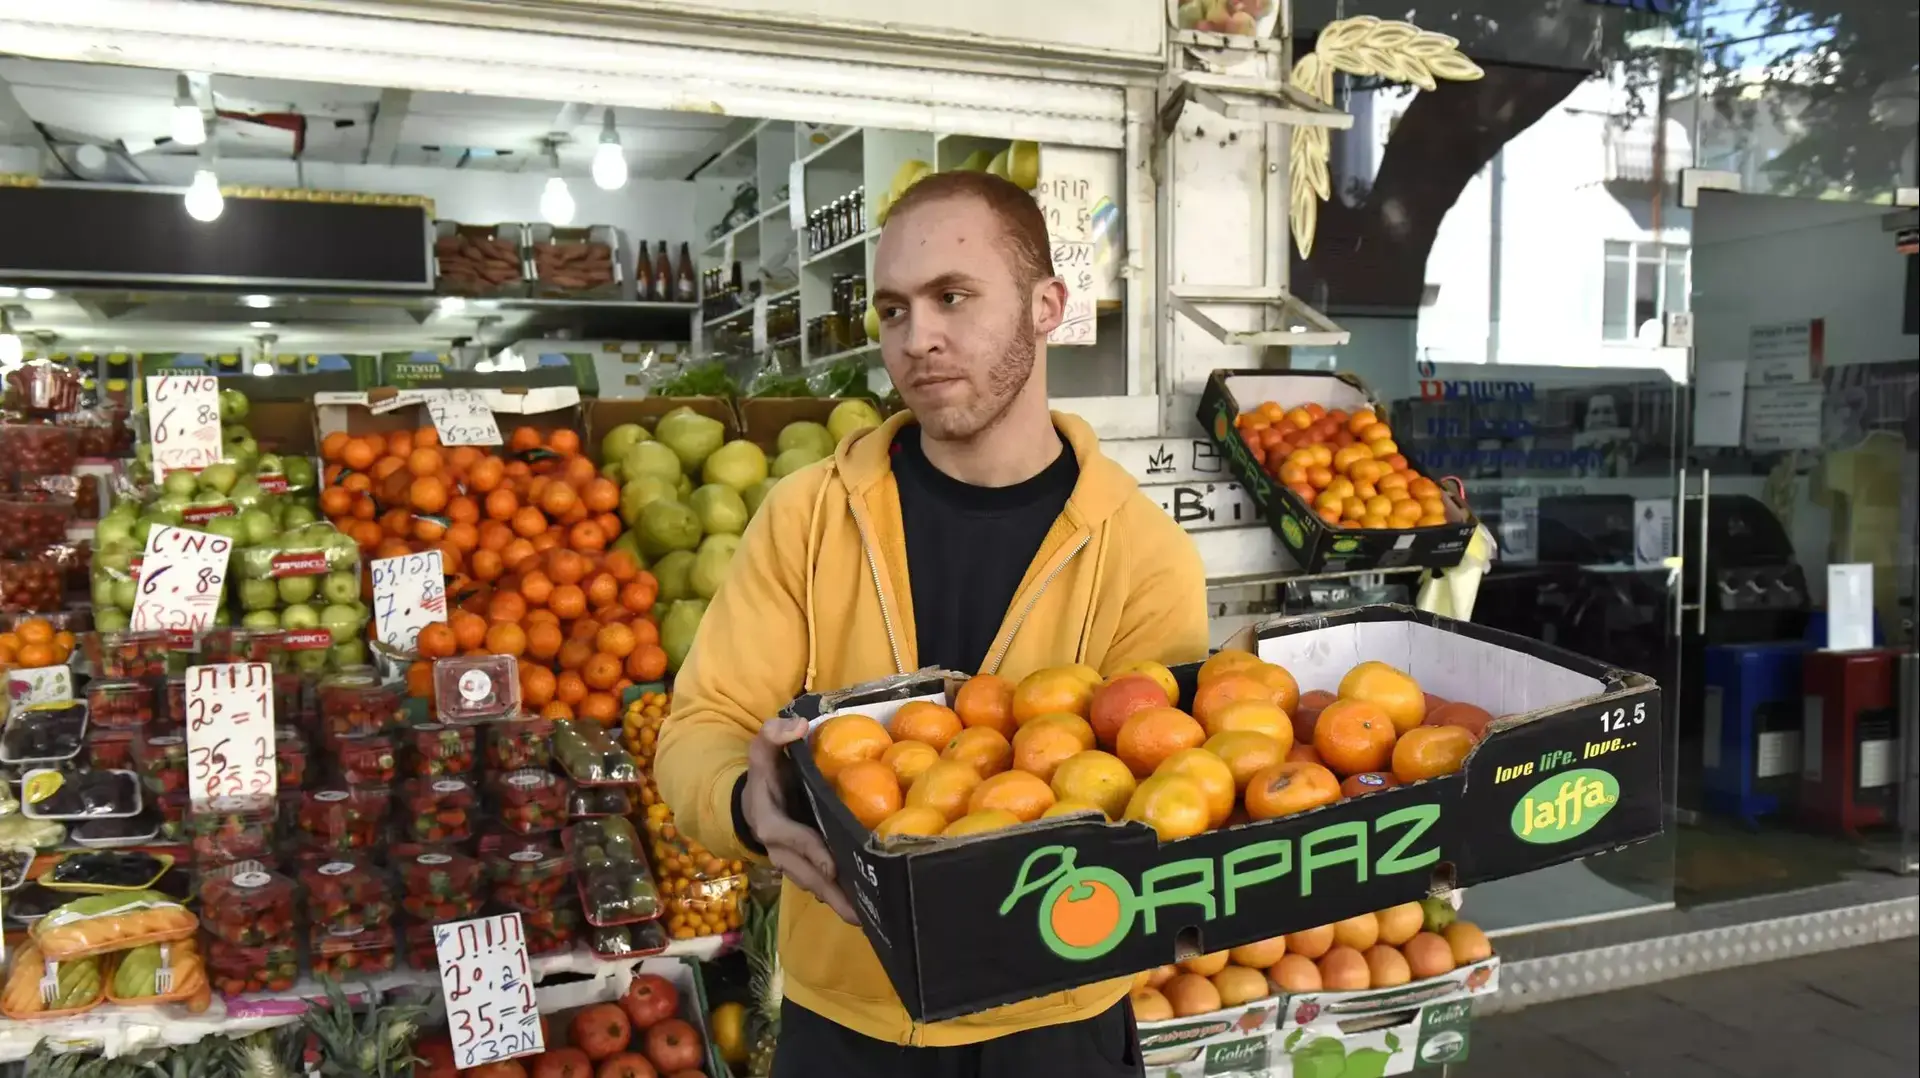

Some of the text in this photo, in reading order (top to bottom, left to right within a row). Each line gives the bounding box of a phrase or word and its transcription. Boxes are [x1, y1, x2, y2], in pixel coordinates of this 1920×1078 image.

[1040, 179, 1089, 202] קוקוס
[191, 663, 267, 693] תות
[189, 697, 222, 731] 20
[256, 692, 267, 719] 1
[1600, 702, 1646, 733] 12.5
[254, 736, 275, 767] 2
[1494, 761, 1534, 785] love
[1539, 749, 1577, 773] life.
[1520, 776, 1608, 836] Jaffa
[1038, 803, 1441, 961] ORPAZ
[455, 913, 521, 961] תות
